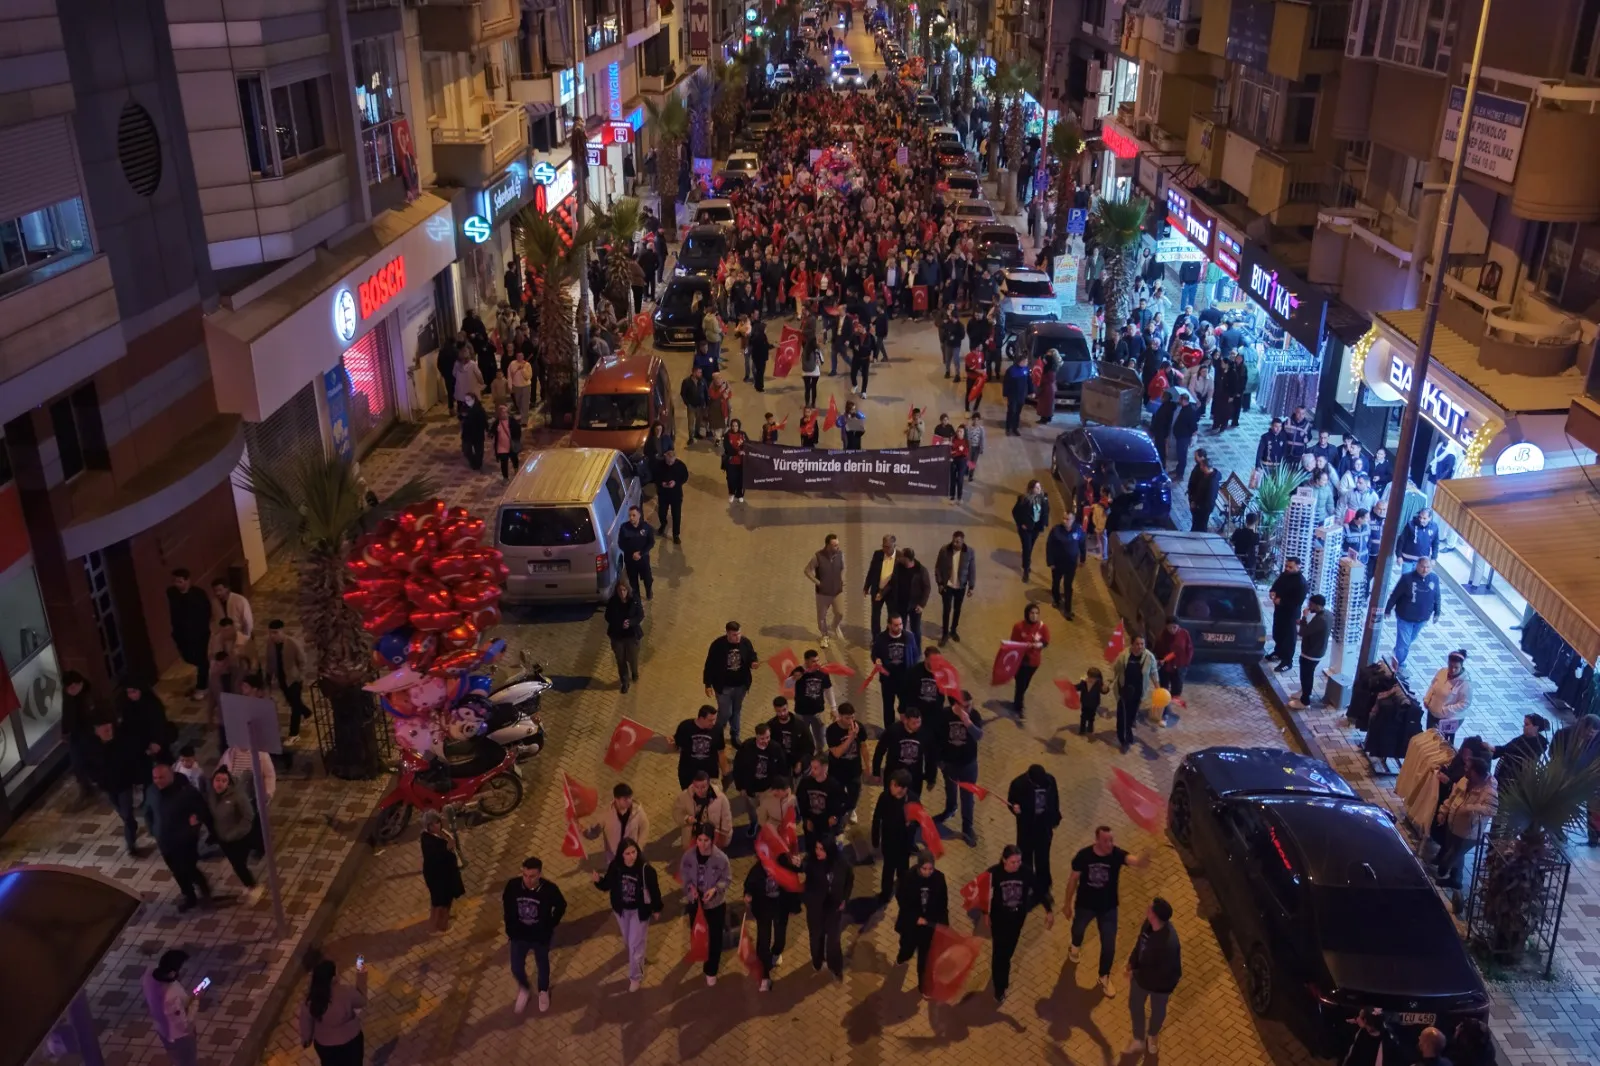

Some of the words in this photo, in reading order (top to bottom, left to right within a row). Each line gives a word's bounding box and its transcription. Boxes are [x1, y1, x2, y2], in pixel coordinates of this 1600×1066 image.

[610, 101, 621, 118] LC
[1072, 209, 1081, 220] P
[358, 255, 407, 321] BOSCH
[772, 458, 841, 474] Yüreğimizde
[843, 459, 873, 473] derin
[875, 460, 890, 473] bir
